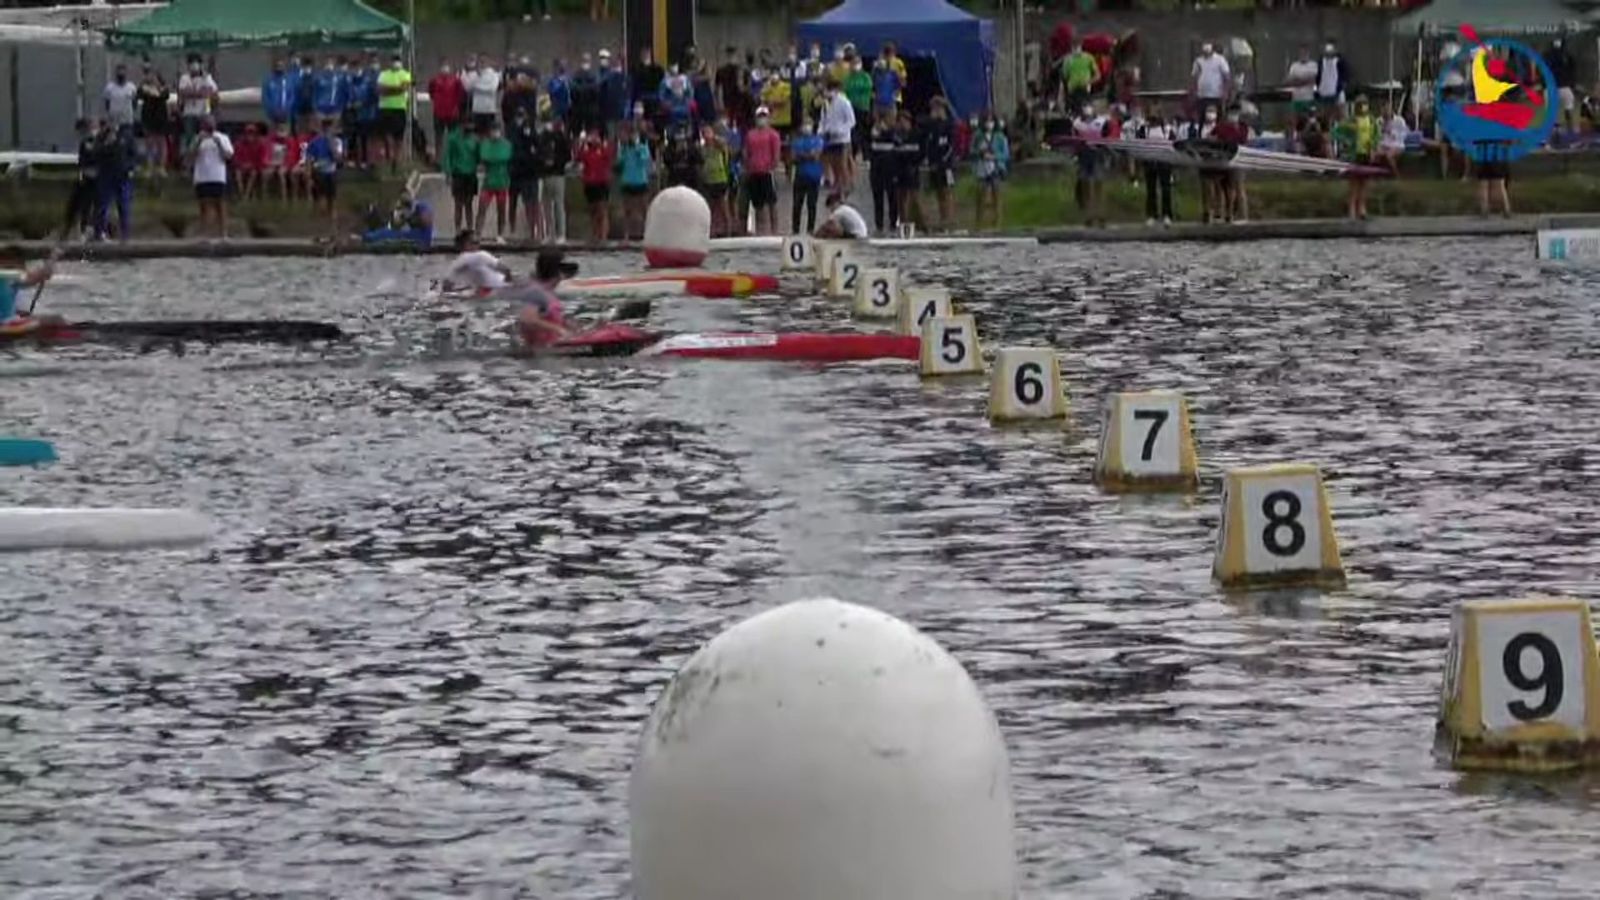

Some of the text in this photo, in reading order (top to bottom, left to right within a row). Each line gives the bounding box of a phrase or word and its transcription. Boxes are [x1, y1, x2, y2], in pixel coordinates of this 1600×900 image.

[790, 242, 803, 262] 0
[843, 264, 858, 289] 2
[872, 279, 890, 307] 3
[941, 327, 966, 364] 5
[1014, 362, 1044, 406] 6
[1133, 409, 1169, 461] 7
[1261, 490, 1306, 557] 8
[1502, 632, 1564, 724] 9
